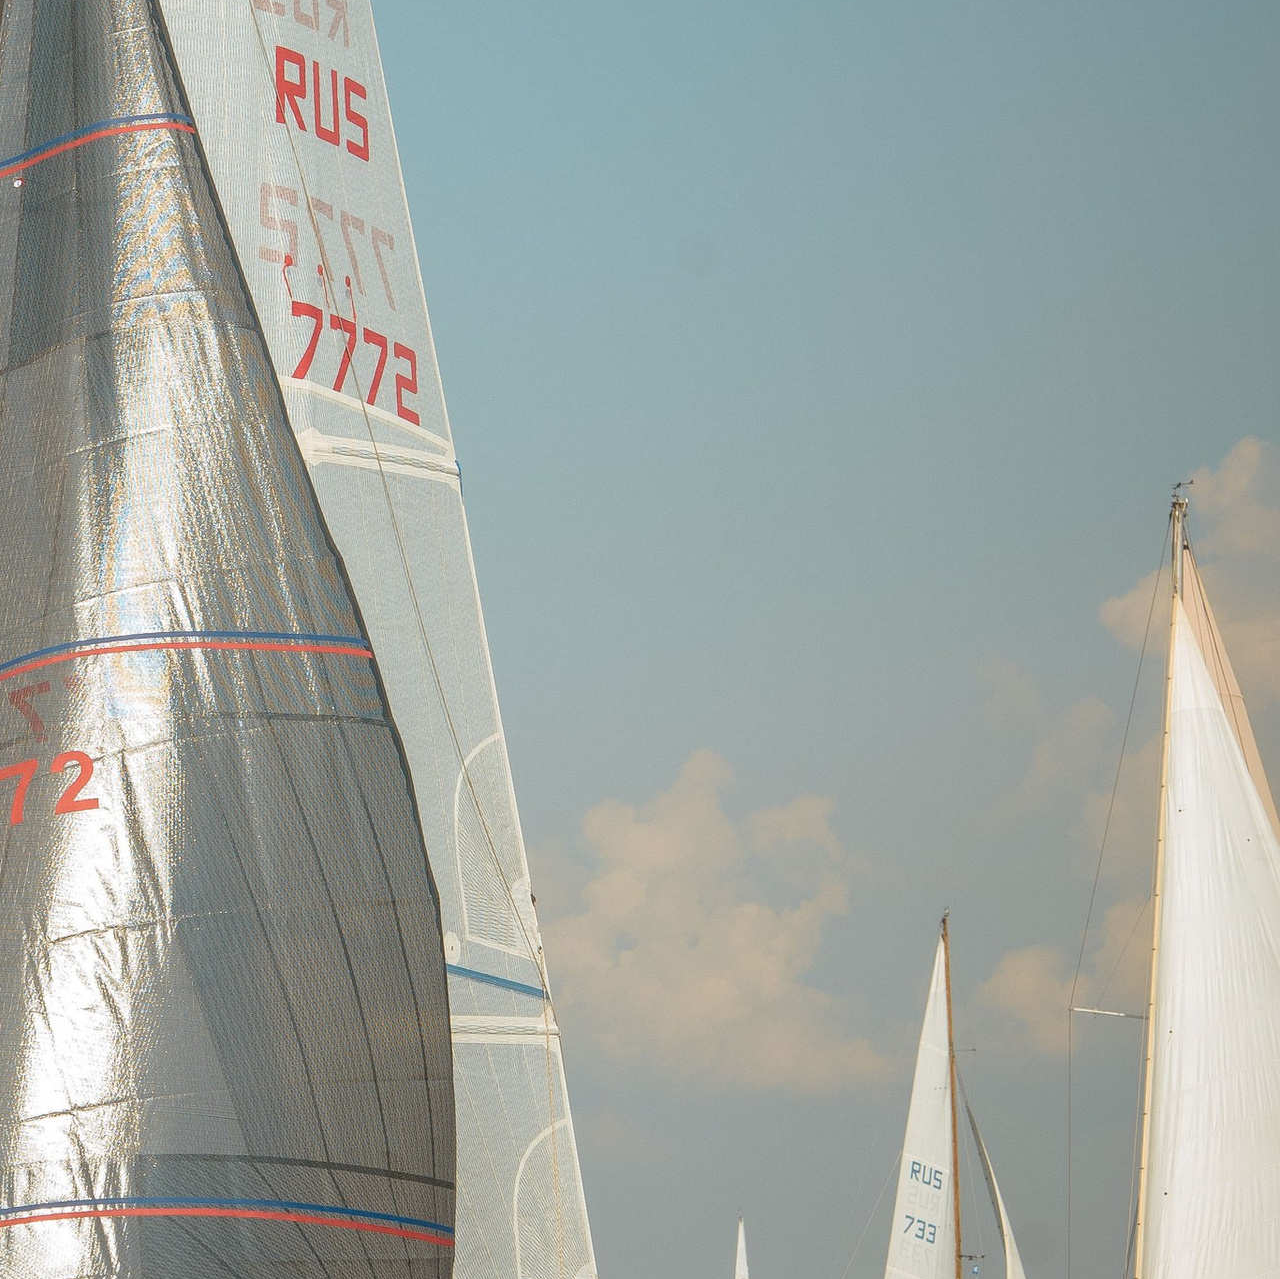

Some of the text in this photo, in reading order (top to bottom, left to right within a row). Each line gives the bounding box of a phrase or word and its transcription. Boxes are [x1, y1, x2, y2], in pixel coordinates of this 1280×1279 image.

[275, 45, 370, 163] RUS
[291, 301, 421, 427] 7772
[910, 1160, 943, 1190] RUS
[902, 1214, 937, 1244] 733
